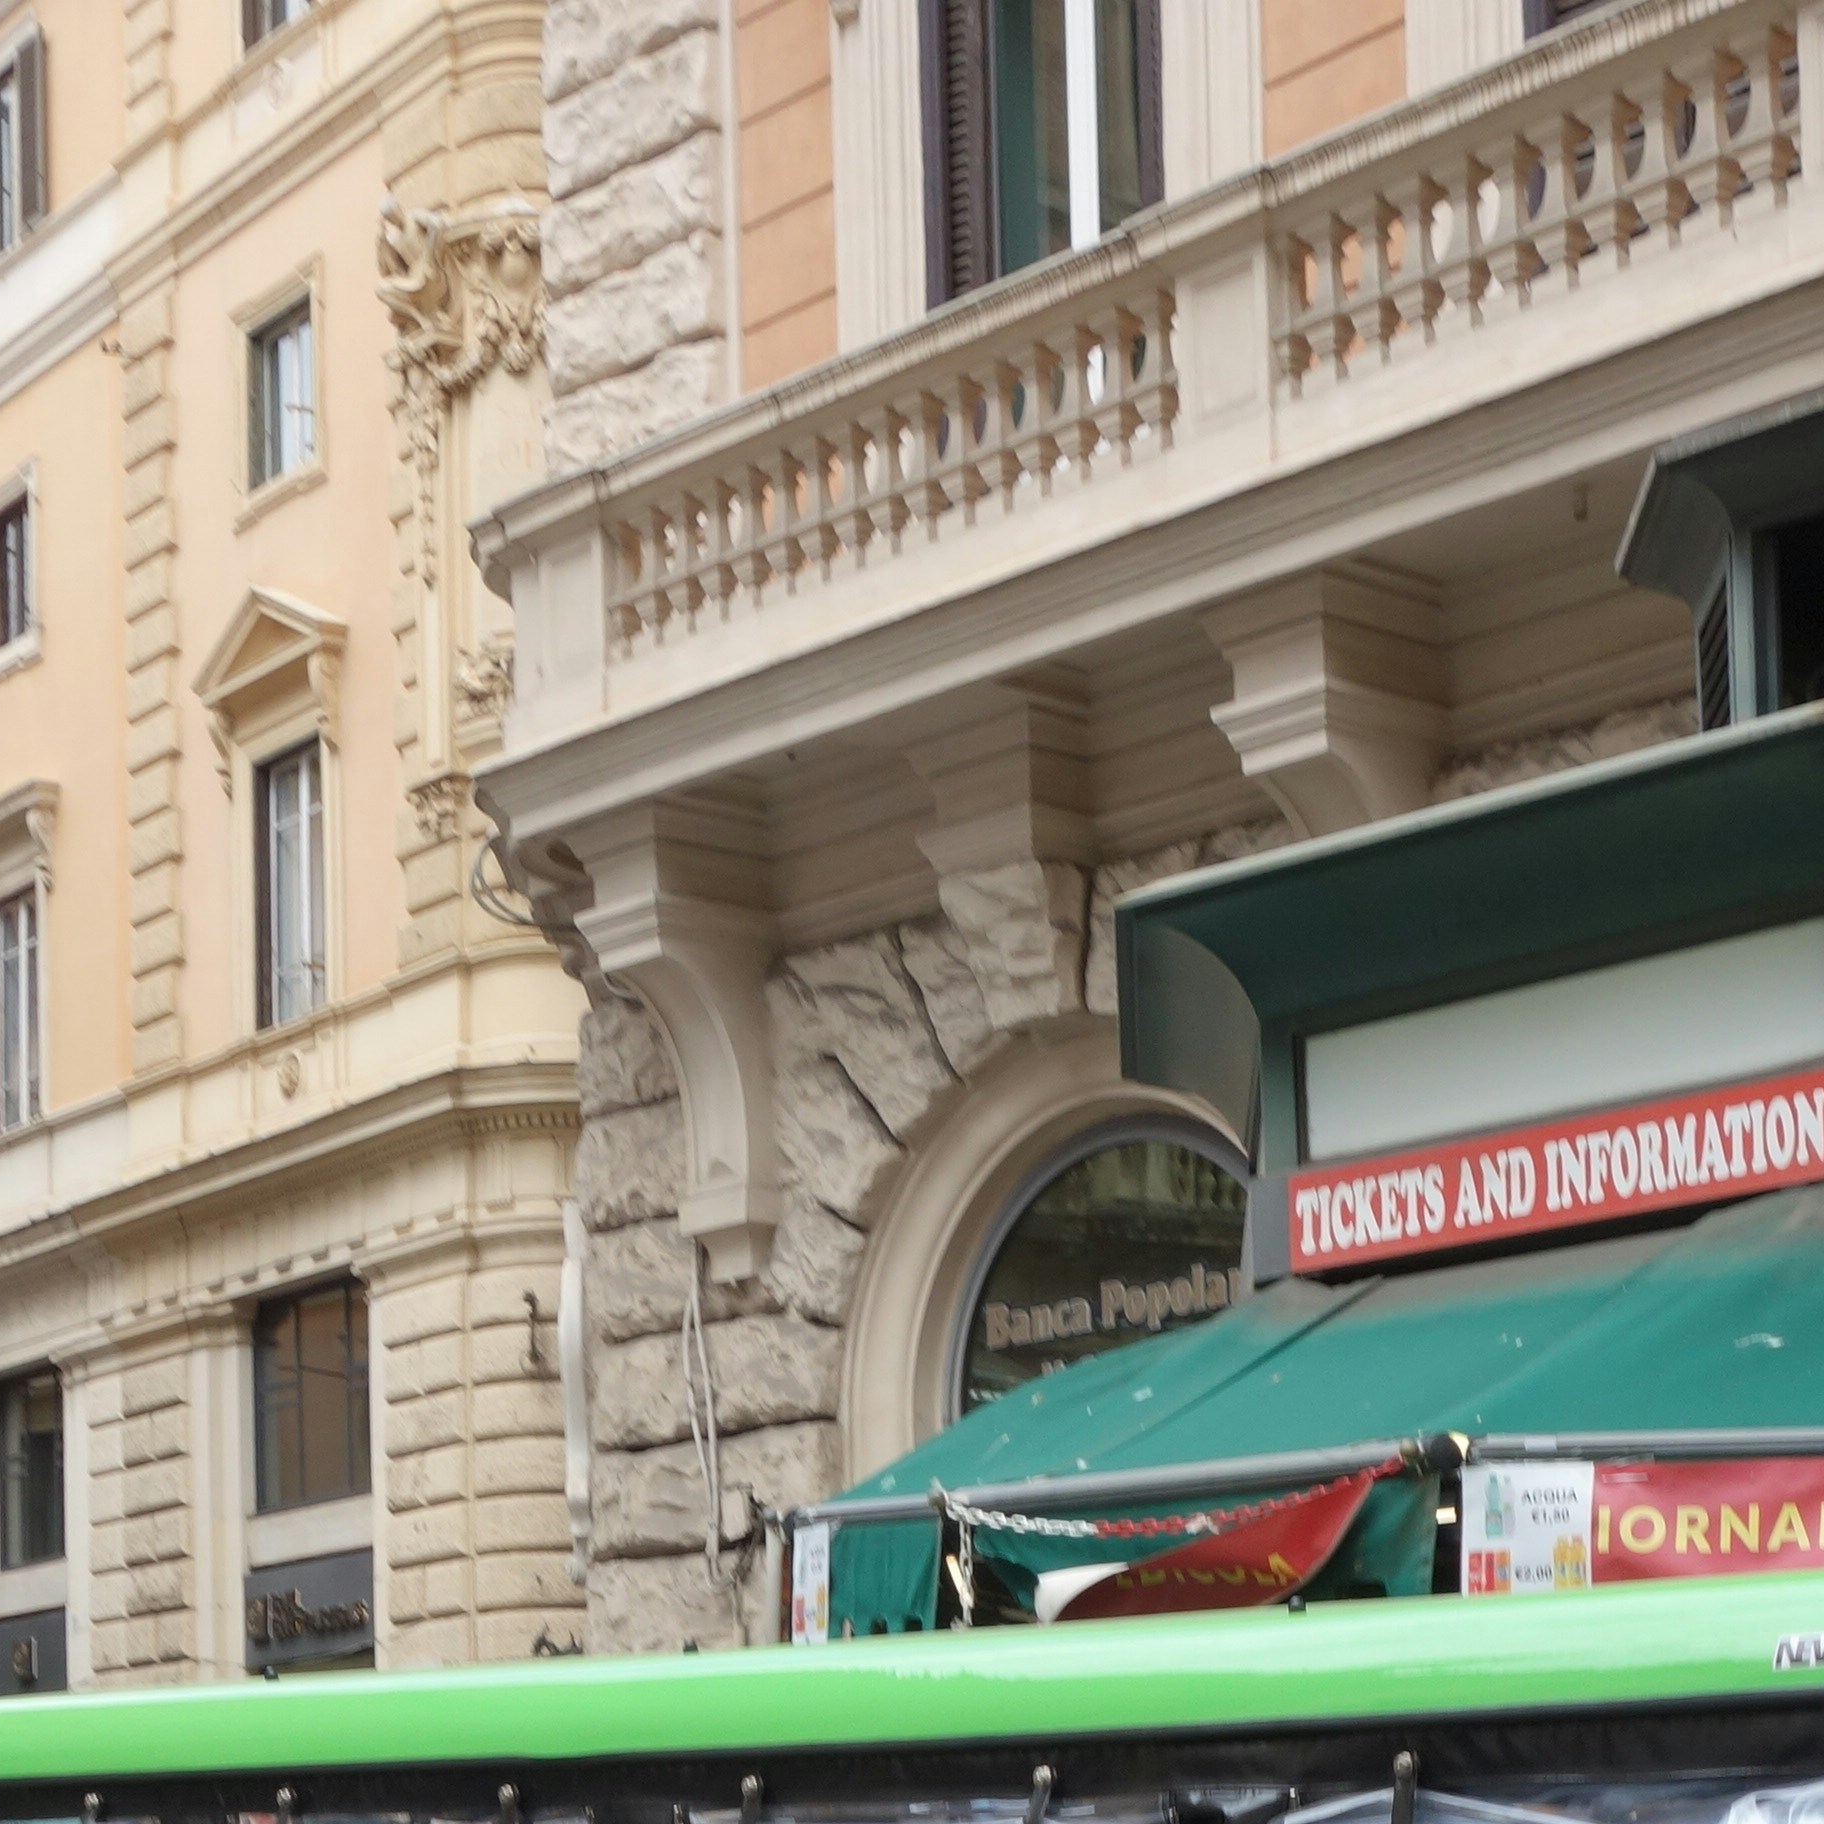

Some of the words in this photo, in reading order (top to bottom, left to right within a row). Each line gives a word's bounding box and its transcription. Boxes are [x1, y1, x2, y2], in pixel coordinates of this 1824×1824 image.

[1295, 1163, 1446, 1258] TICKETS
[1454, 1144, 1536, 1230] AND
[985, 1296, 1093, 1351] Banca
[1521, 1487, 1578, 1506] ACQUA
